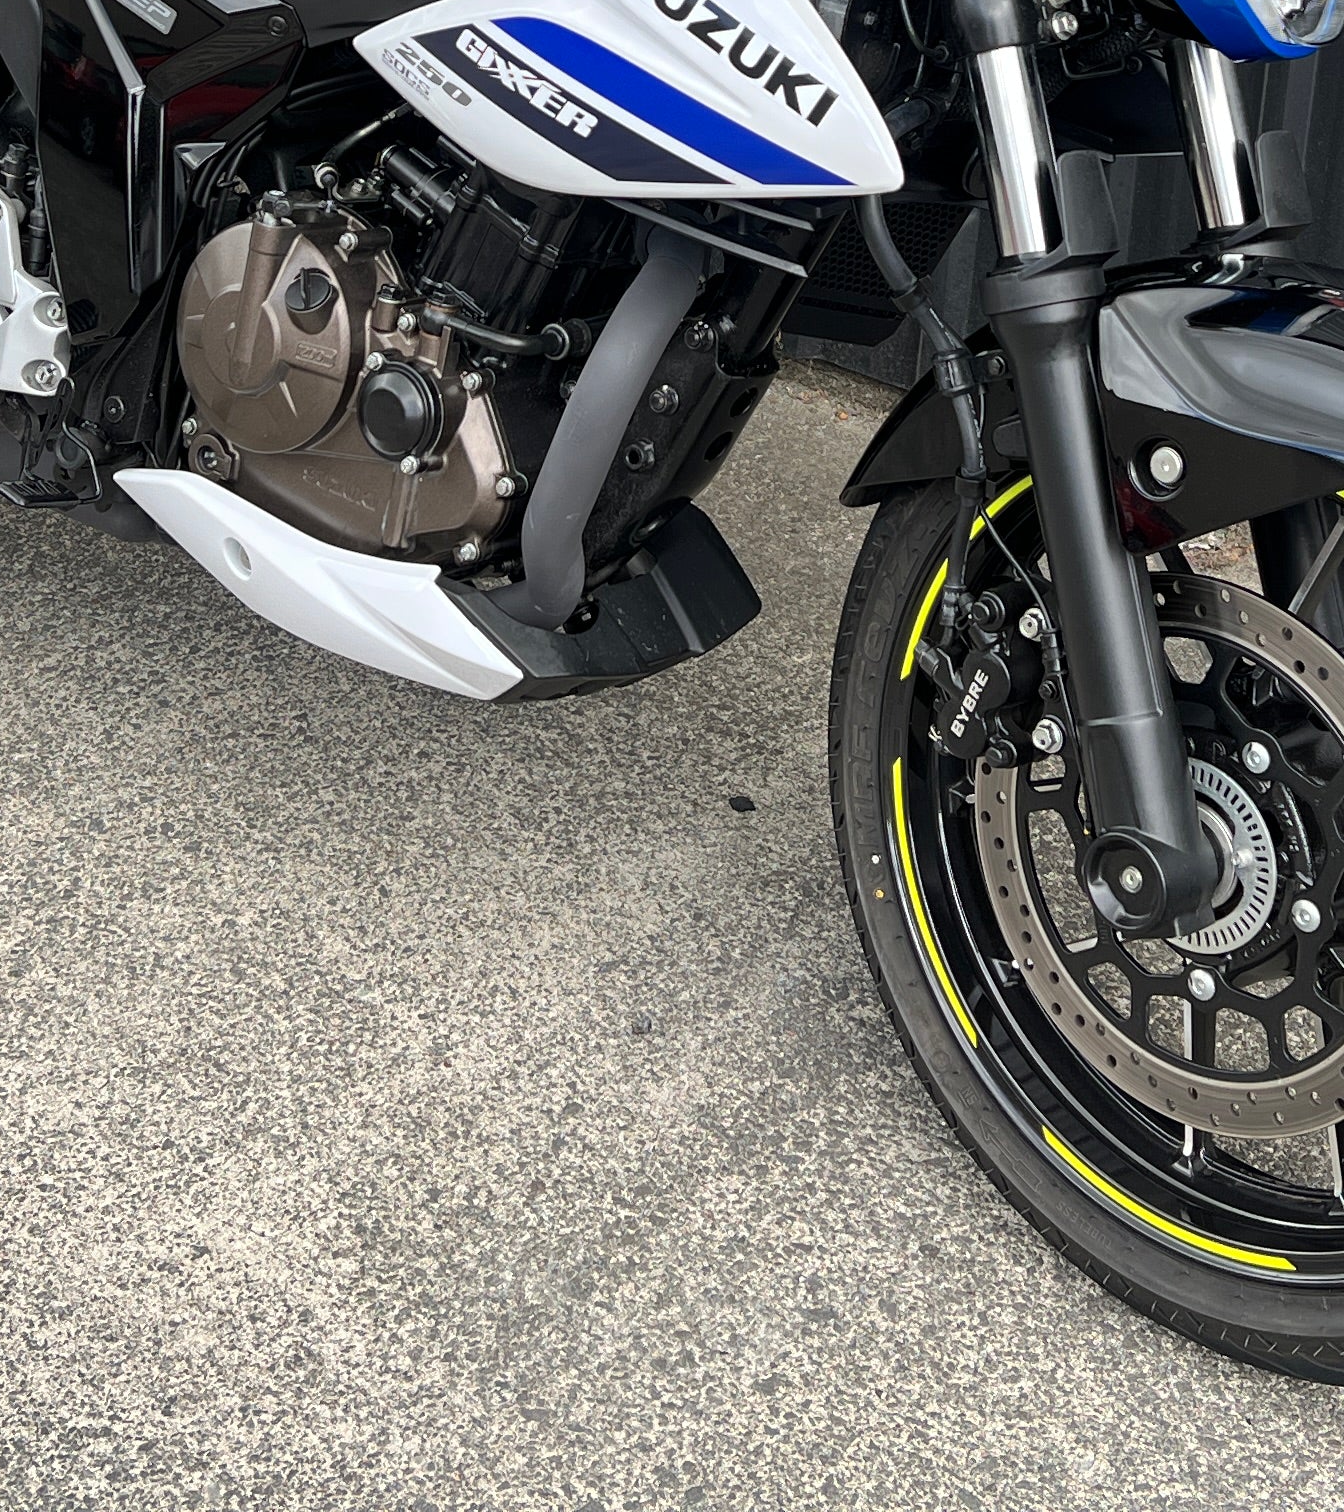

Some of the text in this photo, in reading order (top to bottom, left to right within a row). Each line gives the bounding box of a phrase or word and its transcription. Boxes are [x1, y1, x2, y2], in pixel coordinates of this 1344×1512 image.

[395, 42, 473, 107] 250
[455, 28, 599, 138] GIXXER
[950, 668, 990, 738] BYBRE
